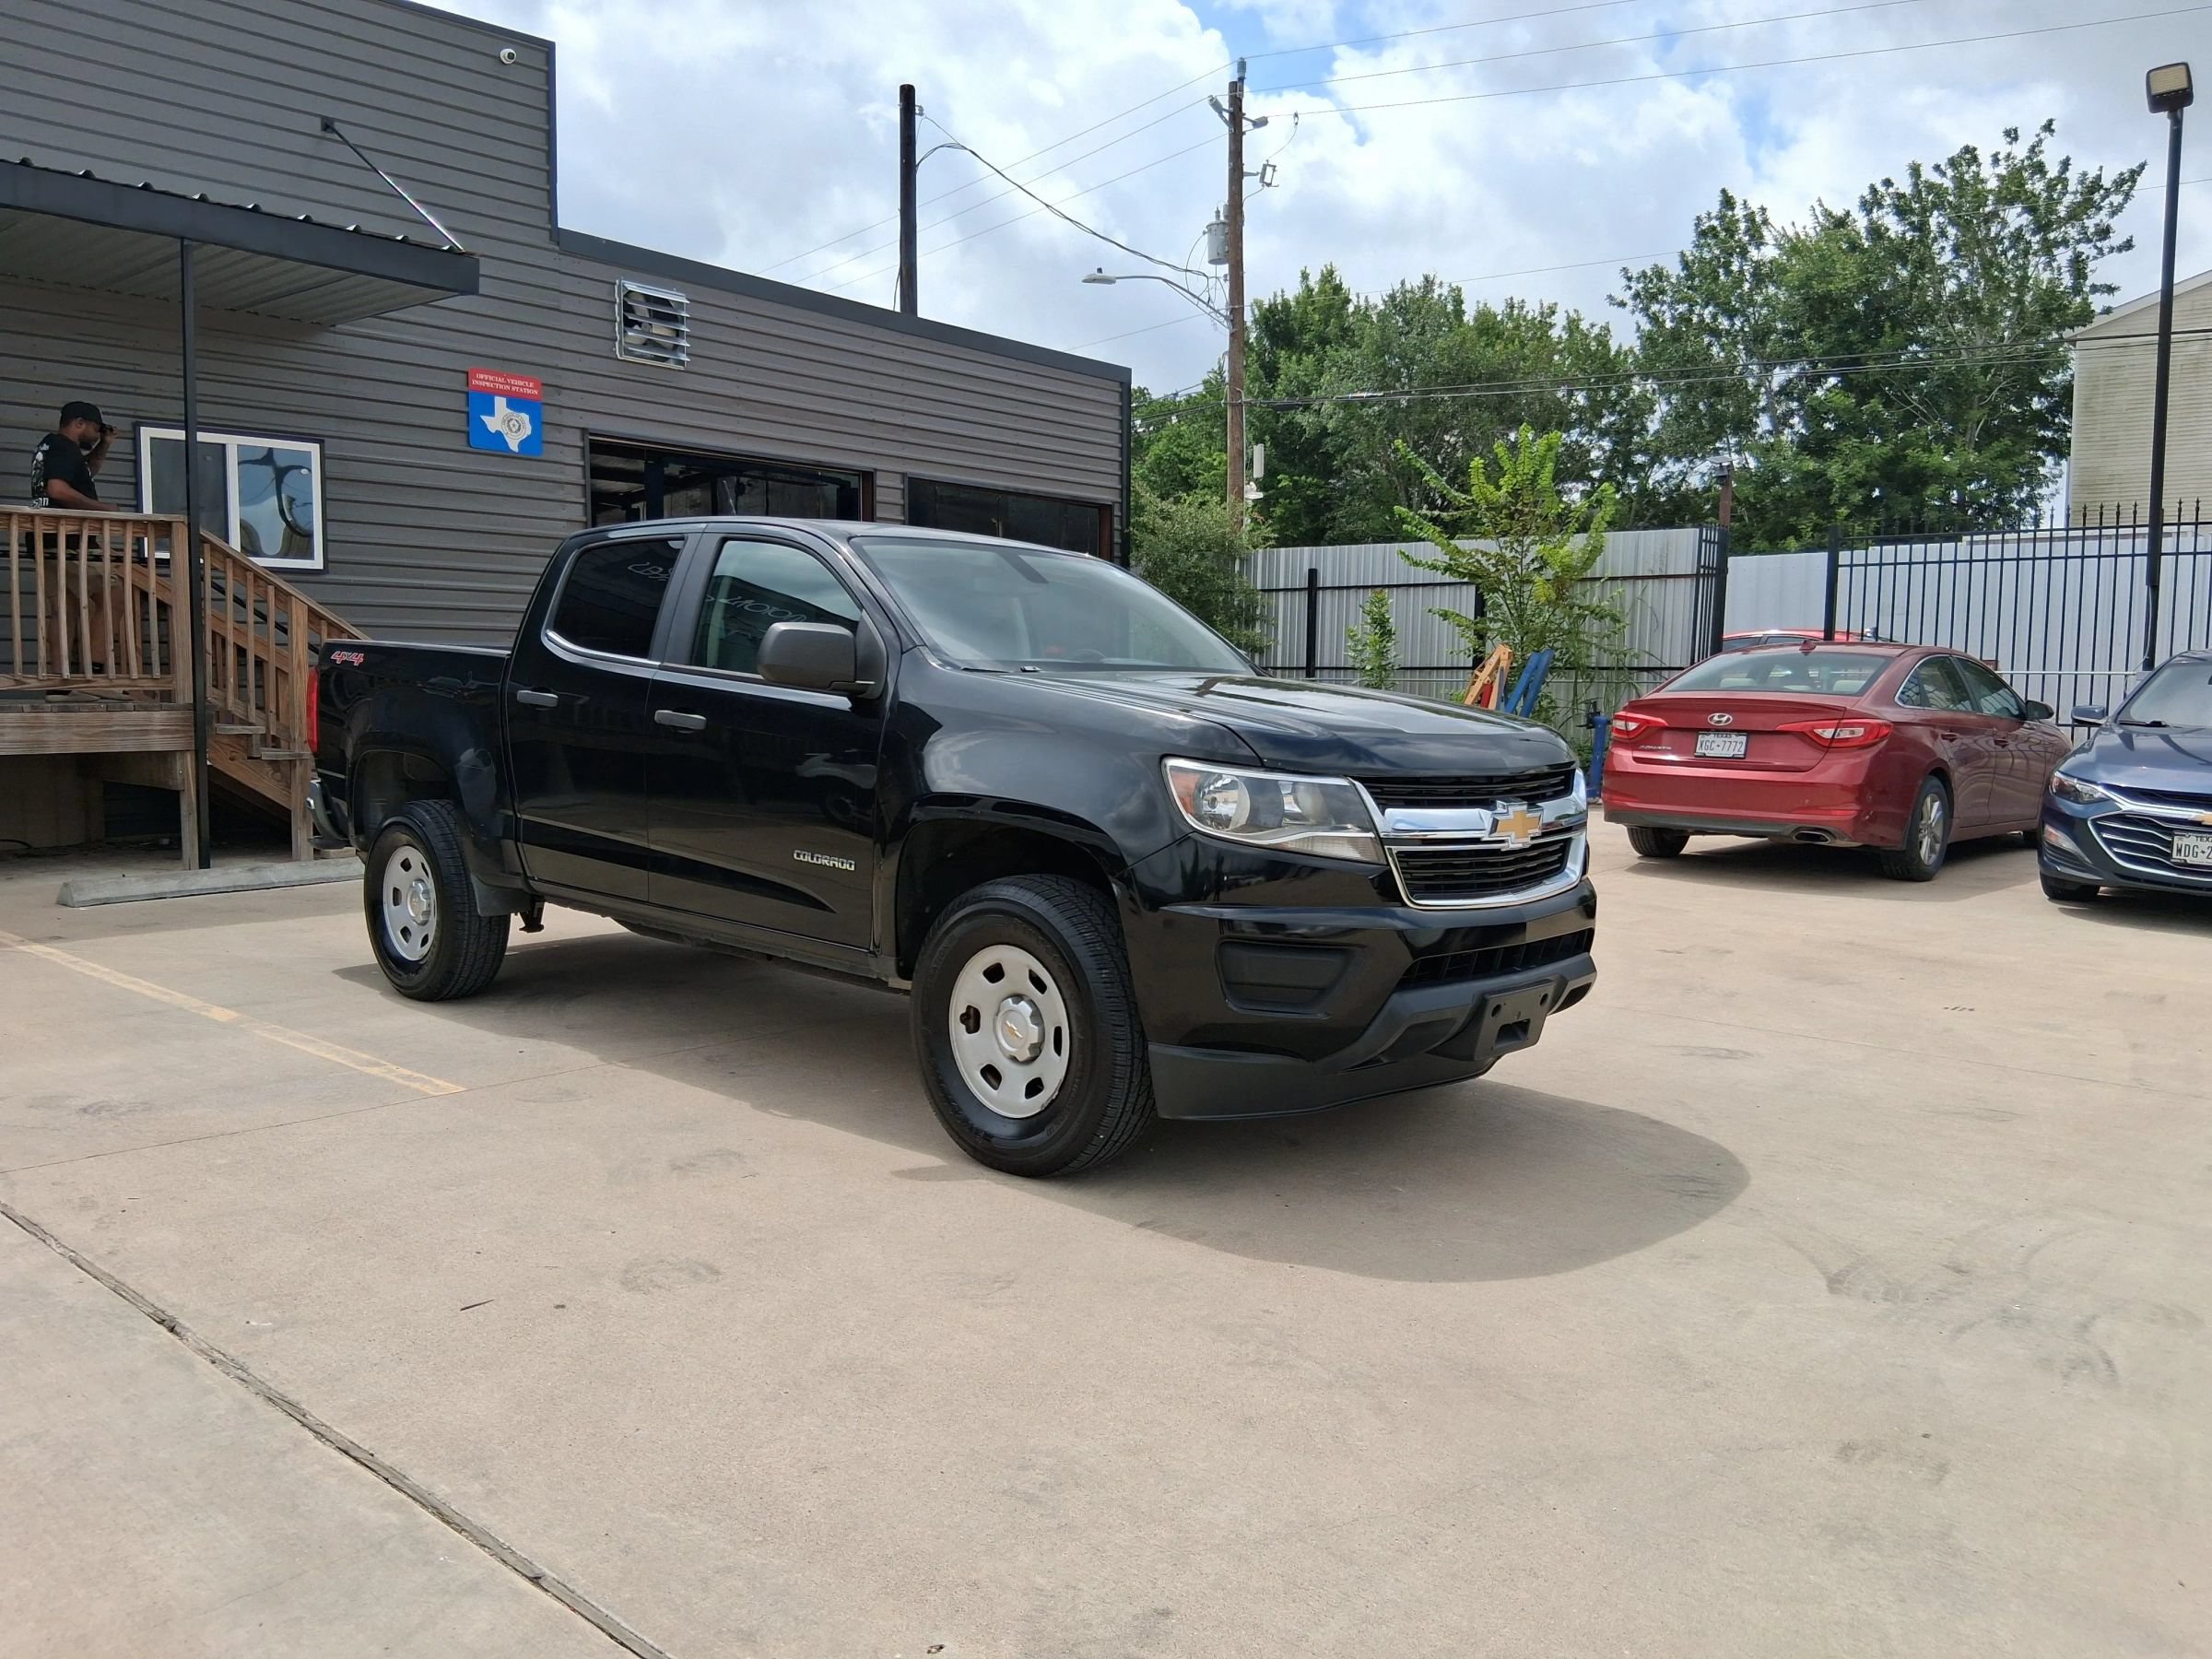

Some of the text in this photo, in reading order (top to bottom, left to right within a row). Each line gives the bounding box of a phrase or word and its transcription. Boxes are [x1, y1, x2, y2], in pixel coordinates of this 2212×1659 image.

[472, 380, 539, 395] INSPECTION STATION
[476, 373, 535, 388] OFFICIAL VEHICLE
[793, 849, 855, 871] COLORADO
